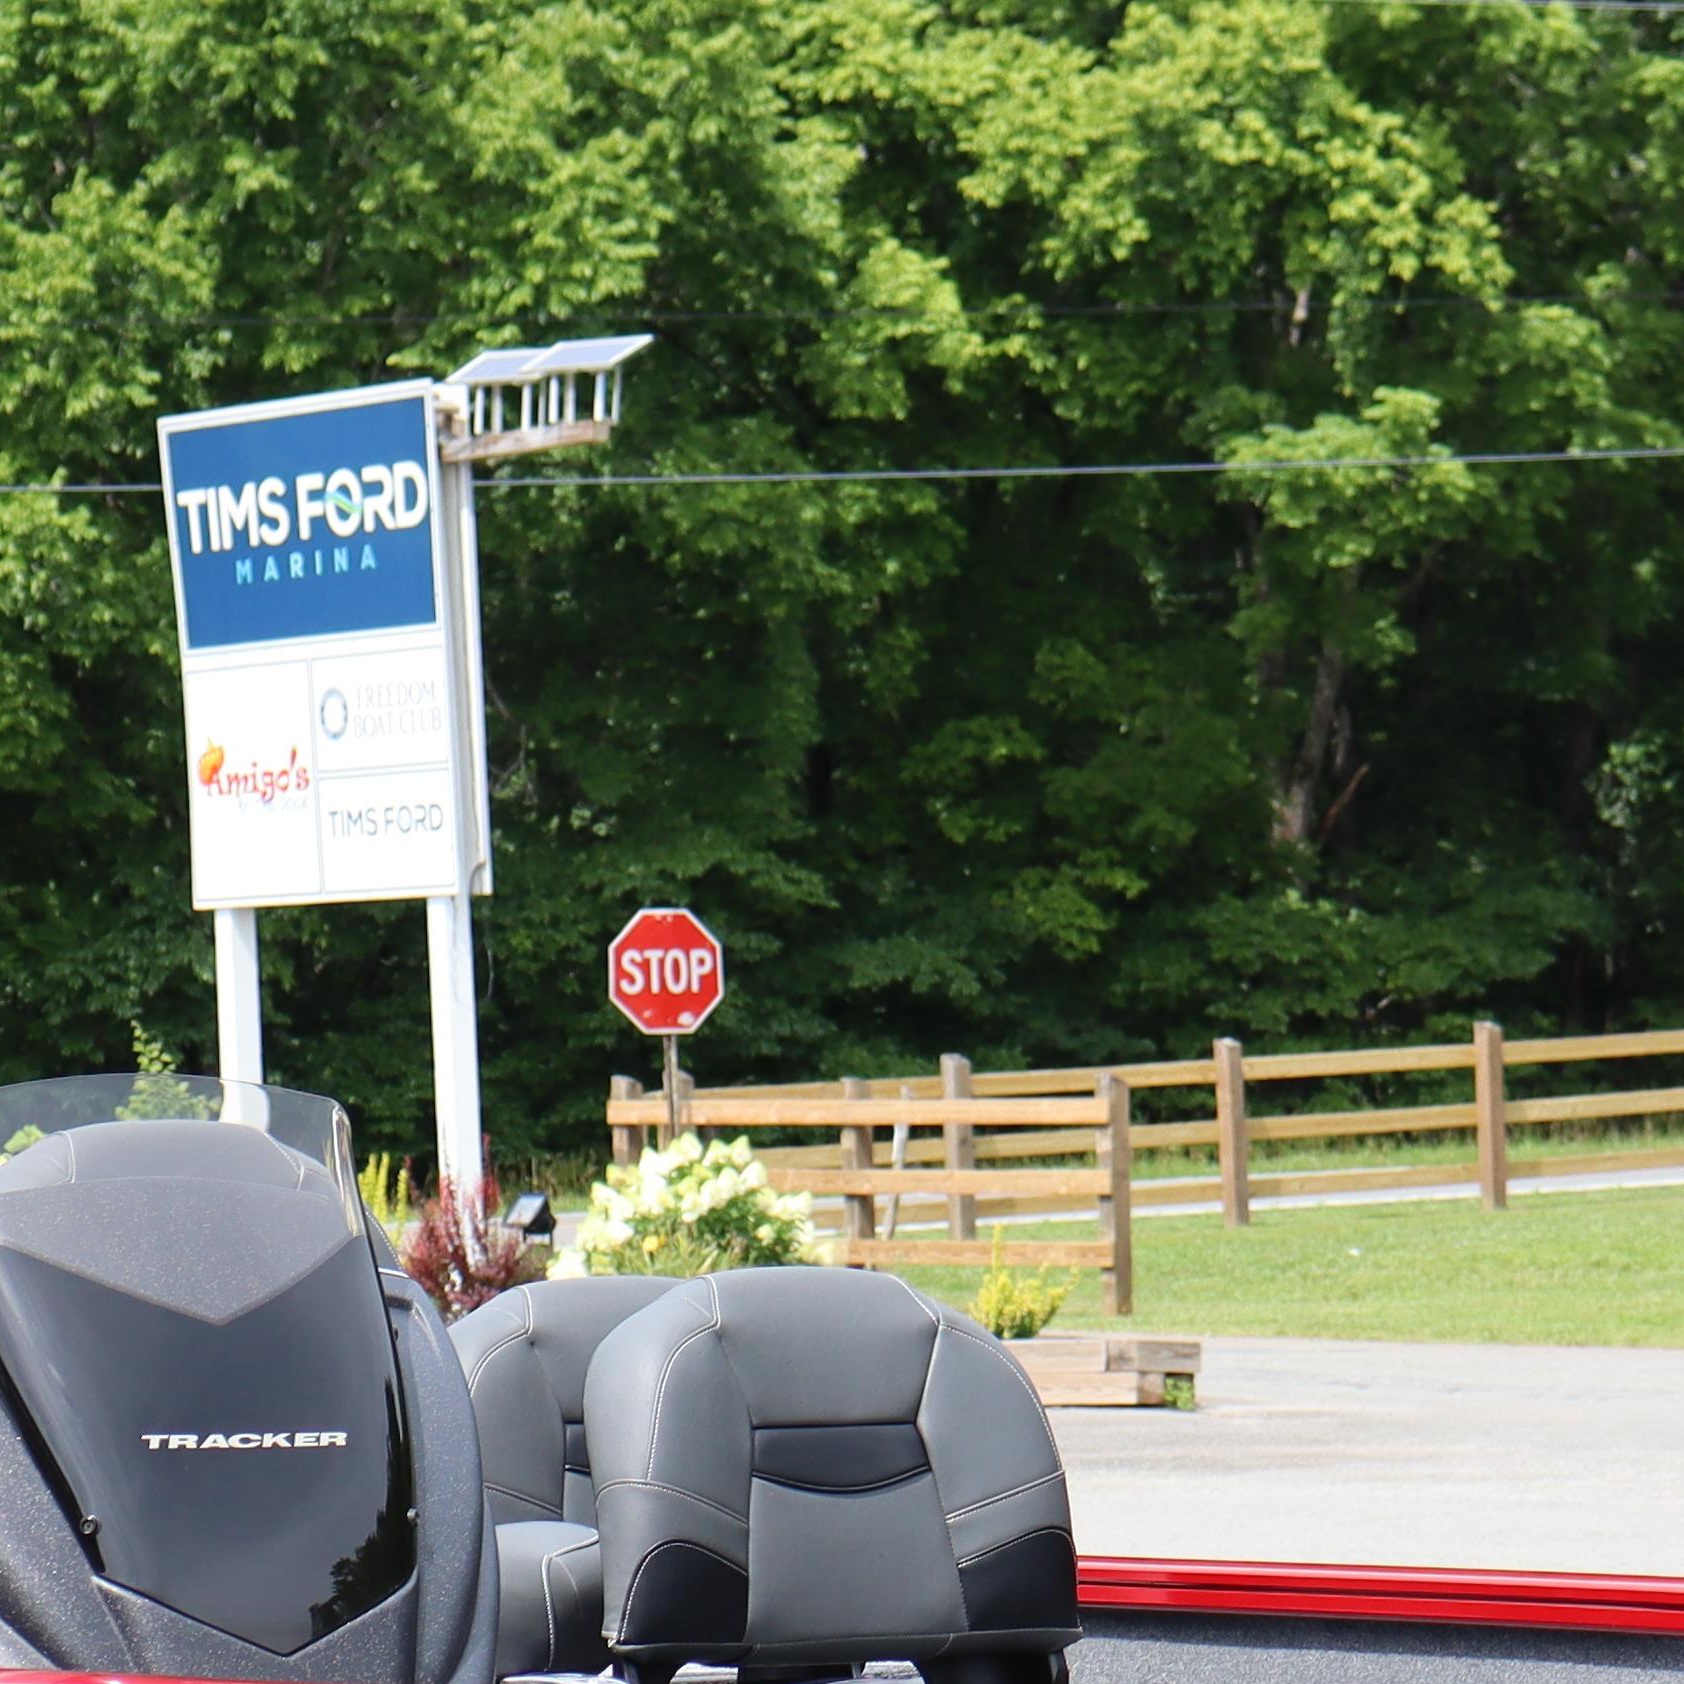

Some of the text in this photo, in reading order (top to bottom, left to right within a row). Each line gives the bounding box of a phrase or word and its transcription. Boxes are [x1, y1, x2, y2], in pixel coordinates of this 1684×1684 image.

[176, 459, 429, 555] TIMS FORD
[234, 543, 377, 586] MARINA
[358, 681, 435, 708] FREEDOM
[354, 706, 442, 737] BOAT CLUB
[201, 743, 312, 805] Amigo's
[328, 803, 444, 838] TIMS FORD
[619, 946, 715, 999] STOP
[141, 1431, 348, 1450] TRACKER
